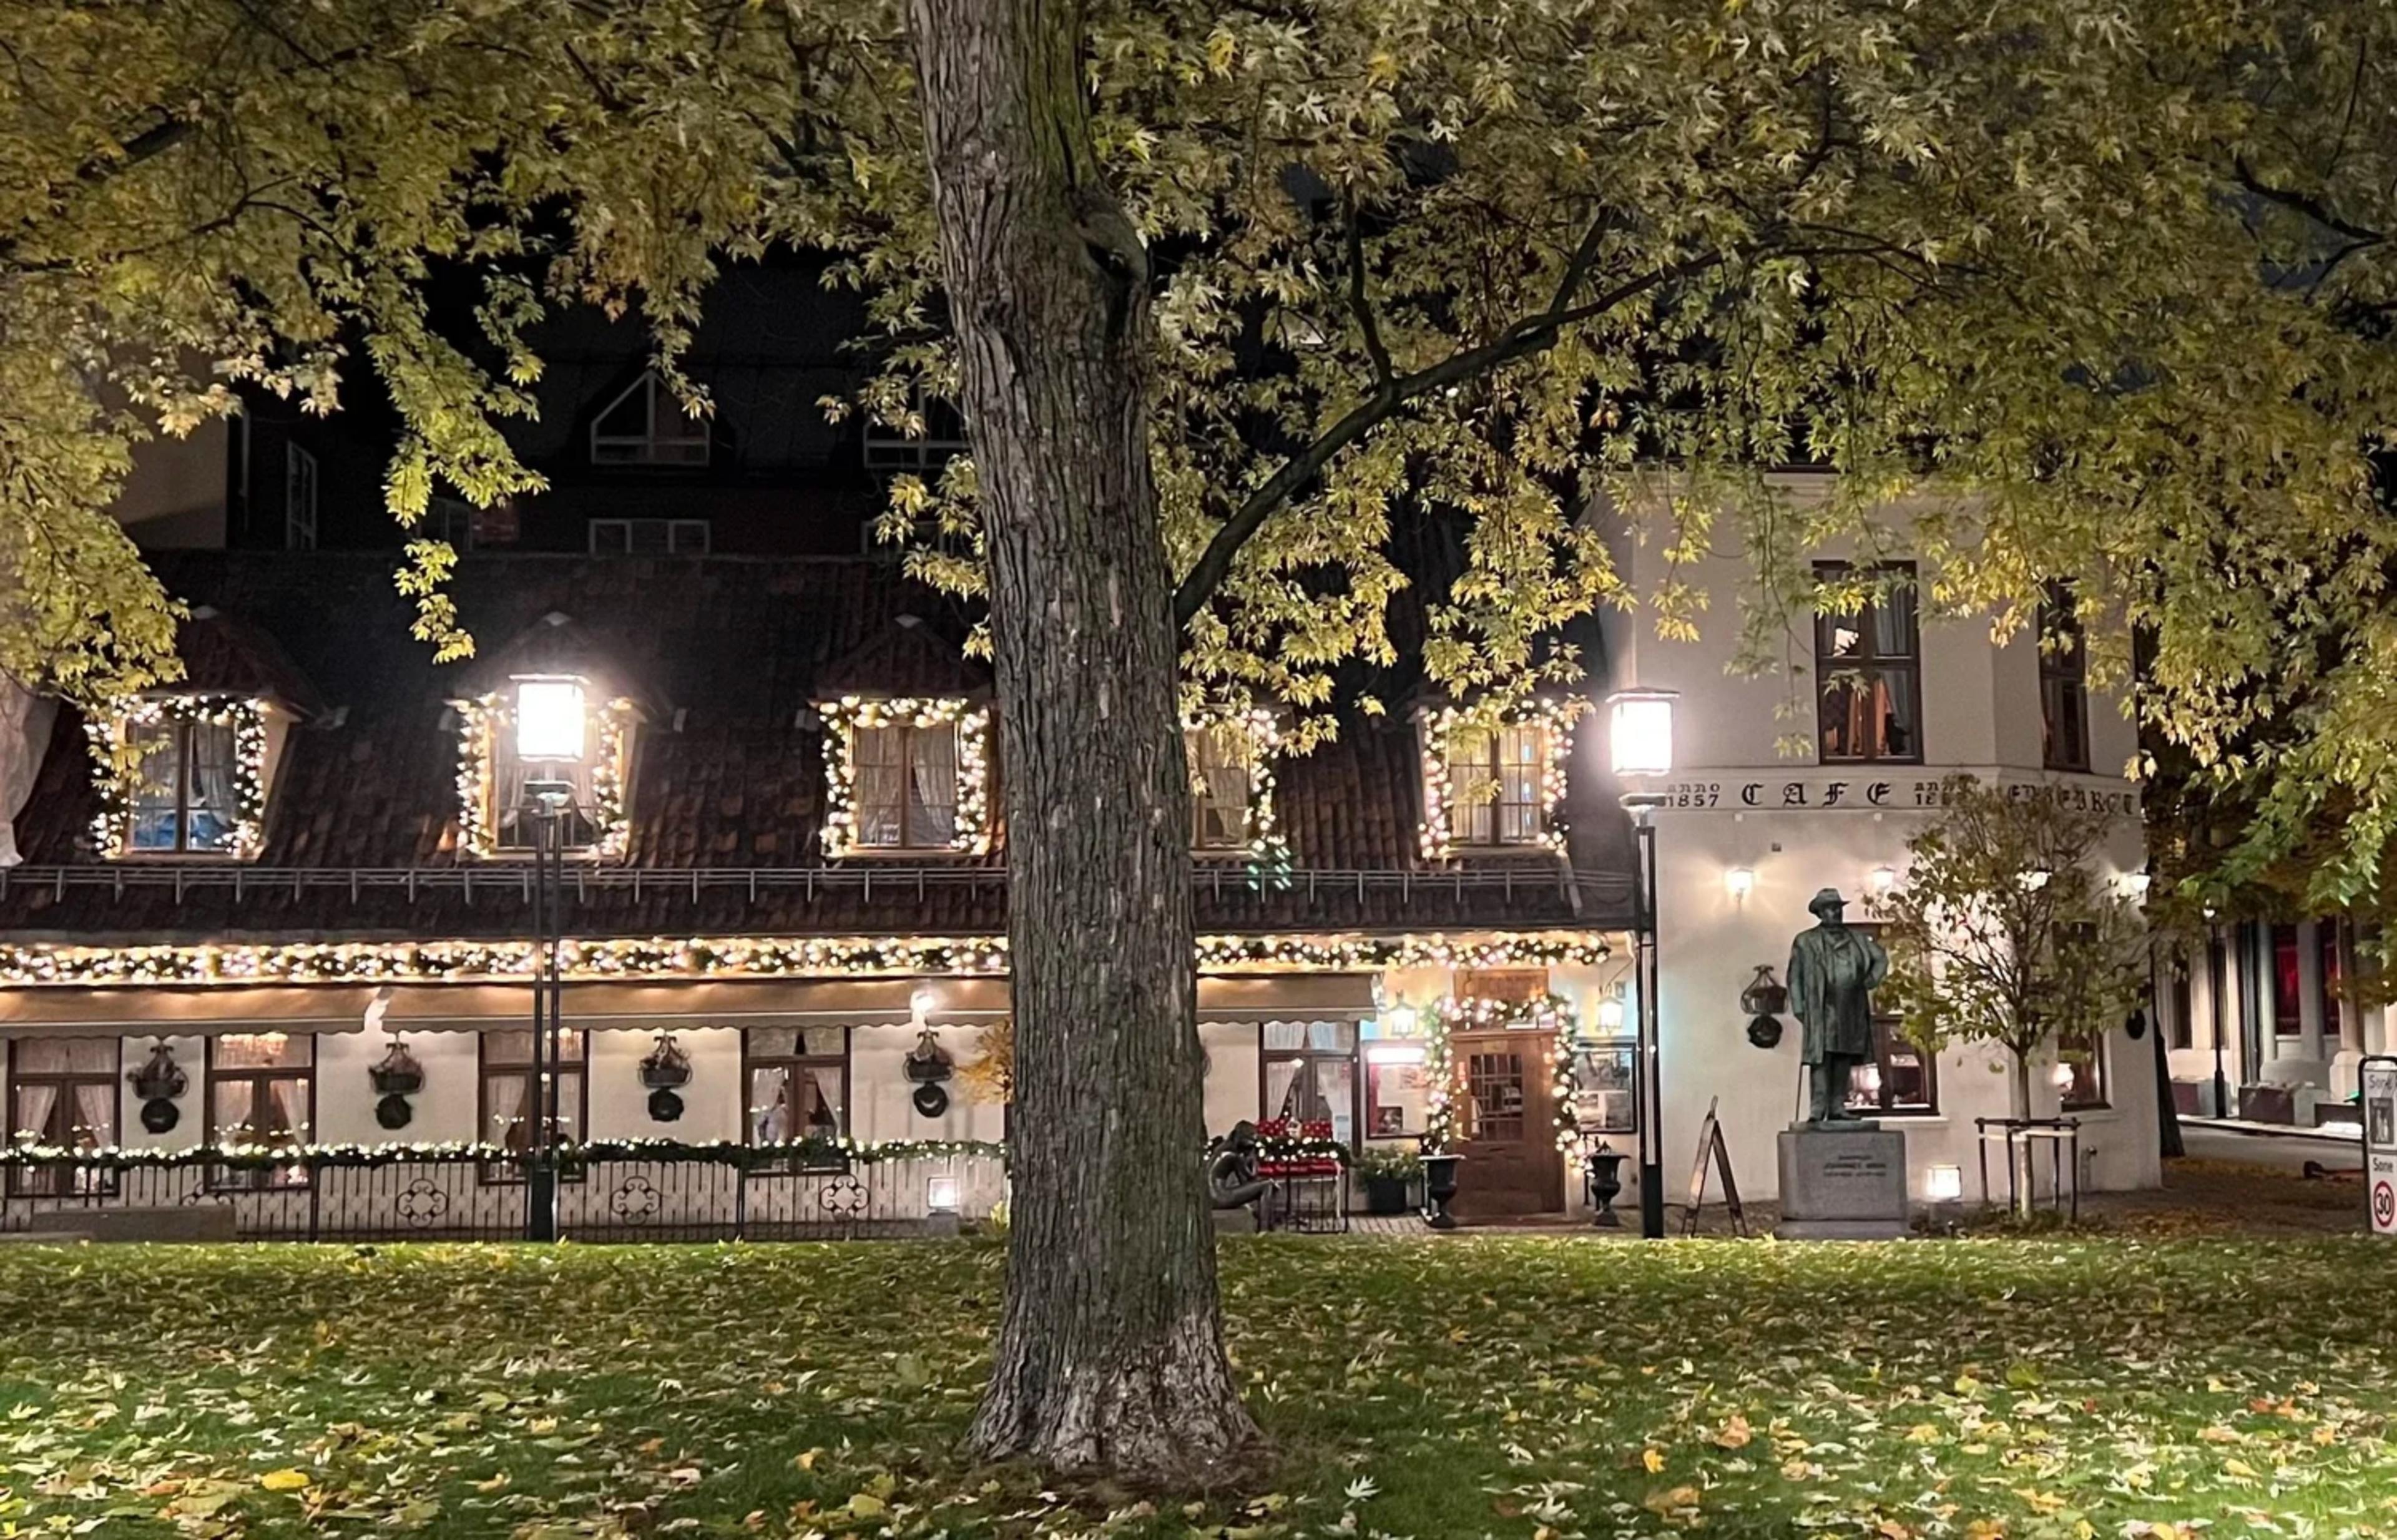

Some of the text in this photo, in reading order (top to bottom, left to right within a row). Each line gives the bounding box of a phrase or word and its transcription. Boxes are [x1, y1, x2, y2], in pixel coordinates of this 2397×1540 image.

[1667, 783, 1720, 793] anno
[1742, 782, 1891, 807] CAFE
[1666, 794, 1720, 807] 1857
[2373, 1157, 2393, 1173] Sone
[2377, 1192, 2392, 1215] 30
